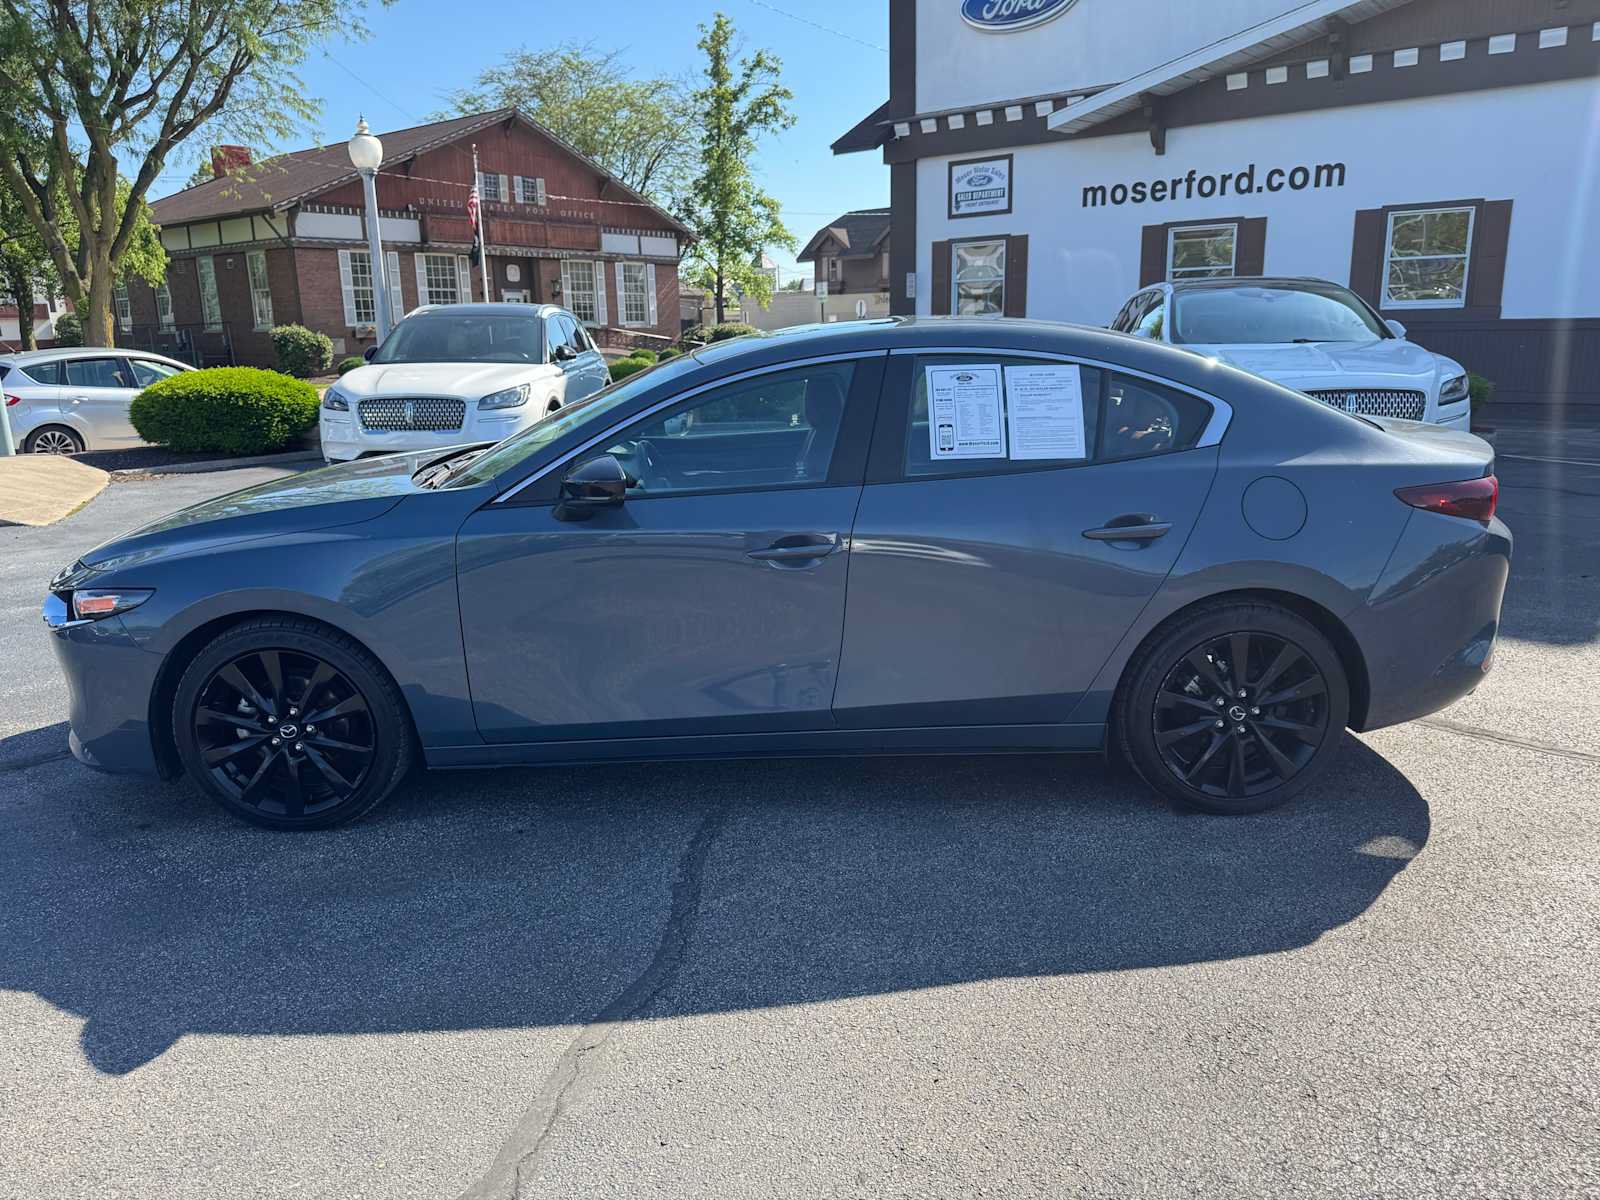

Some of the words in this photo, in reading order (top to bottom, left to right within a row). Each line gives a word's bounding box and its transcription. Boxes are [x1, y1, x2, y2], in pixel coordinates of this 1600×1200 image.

[957, 191, 972, 201] SALES
[972, 189, 1004, 200] DEPARTMENT
[1082, 161, 1346, 208] moserford.com
[419, 198, 463, 208] UNITED
[475, 203, 515, 213] TATES
[525, 206, 550, 215] POST
[560, 210, 595, 220] OFFICE
